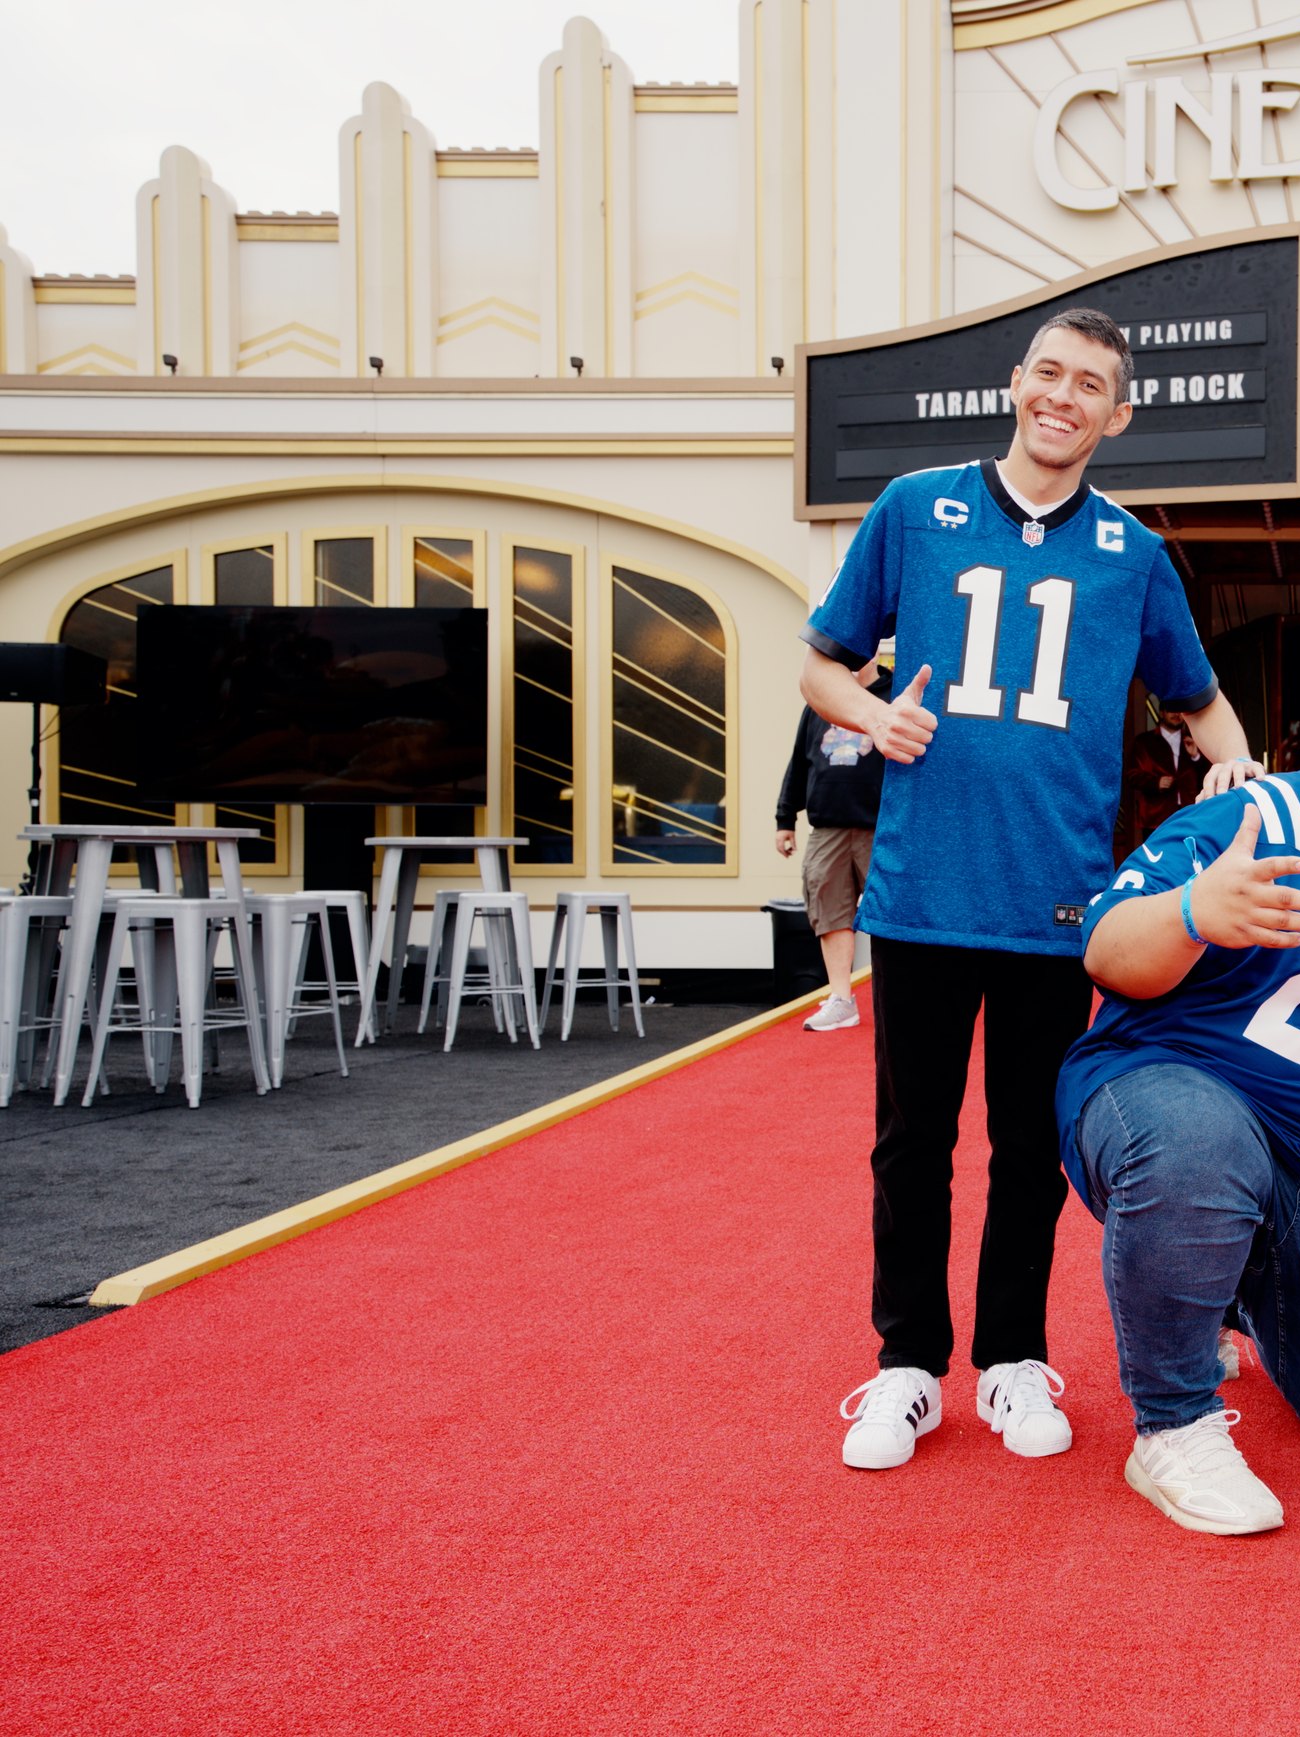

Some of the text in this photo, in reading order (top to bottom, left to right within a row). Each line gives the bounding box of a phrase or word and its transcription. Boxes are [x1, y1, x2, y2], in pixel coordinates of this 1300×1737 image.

[1140, 319, 1233, 346] PLAYING
[1169, 372, 1246, 404] ROCK
[933, 497, 969, 525] C
[1025, 531, 1042, 542] NFL
[1096, 519, 1124, 552] C
[944, 563, 1077, 733] 11
